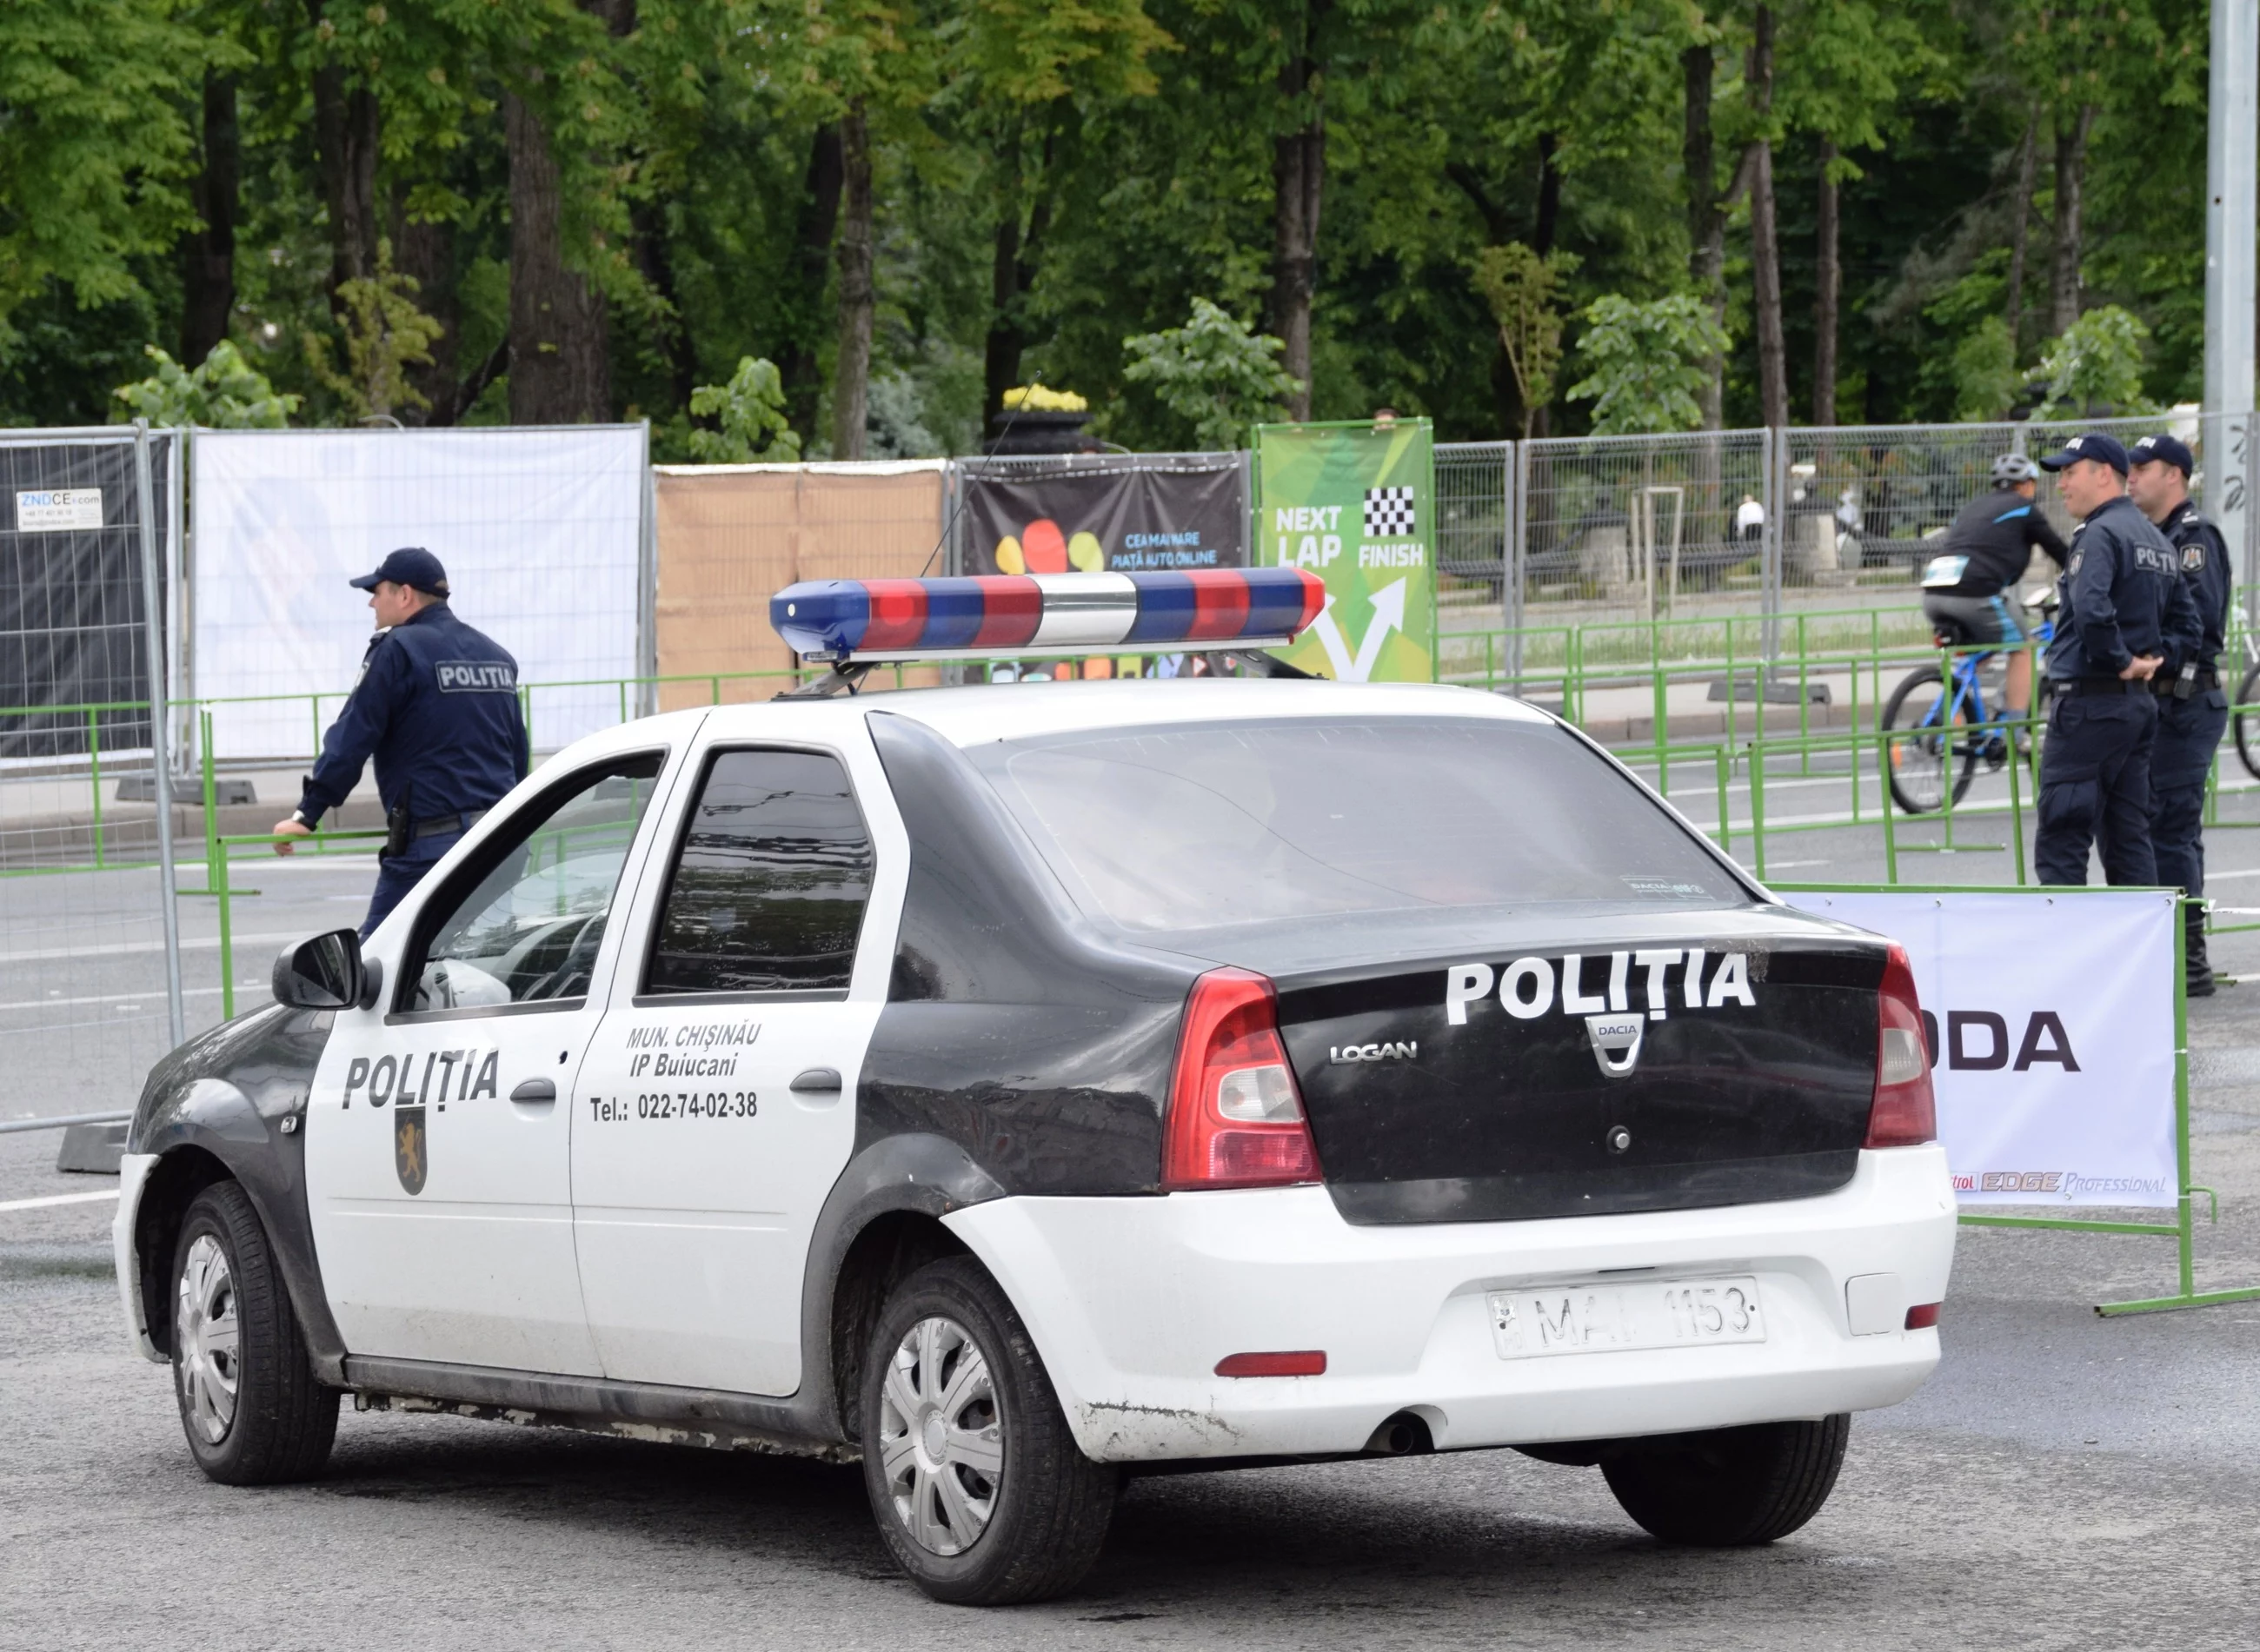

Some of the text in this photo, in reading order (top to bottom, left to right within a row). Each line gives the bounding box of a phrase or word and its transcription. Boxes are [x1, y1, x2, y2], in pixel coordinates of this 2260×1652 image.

[1276, 506, 1342, 532] NEXT
[1175, 549, 1218, 567] ONLINE
[1278, 534, 1342, 568] LAP
[1359, 543, 1424, 569] FINISH
[1446, 948, 1757, 1025] POLIȚIA
[626, 1026, 668, 1049] MUN.
[1599, 1025, 1638, 1036] DACIA
[629, 1052, 739, 1078] IP Buiucani
[1330, 1041, 1417, 1065] LOGAN
[342, 1048, 500, 1112] POLIȚIA
[590, 1091, 757, 1122] Tel.: 022-74-02-38
[1951, 1174, 1974, 1190] trol
[1981, 1171, 2063, 1192] EDGE
